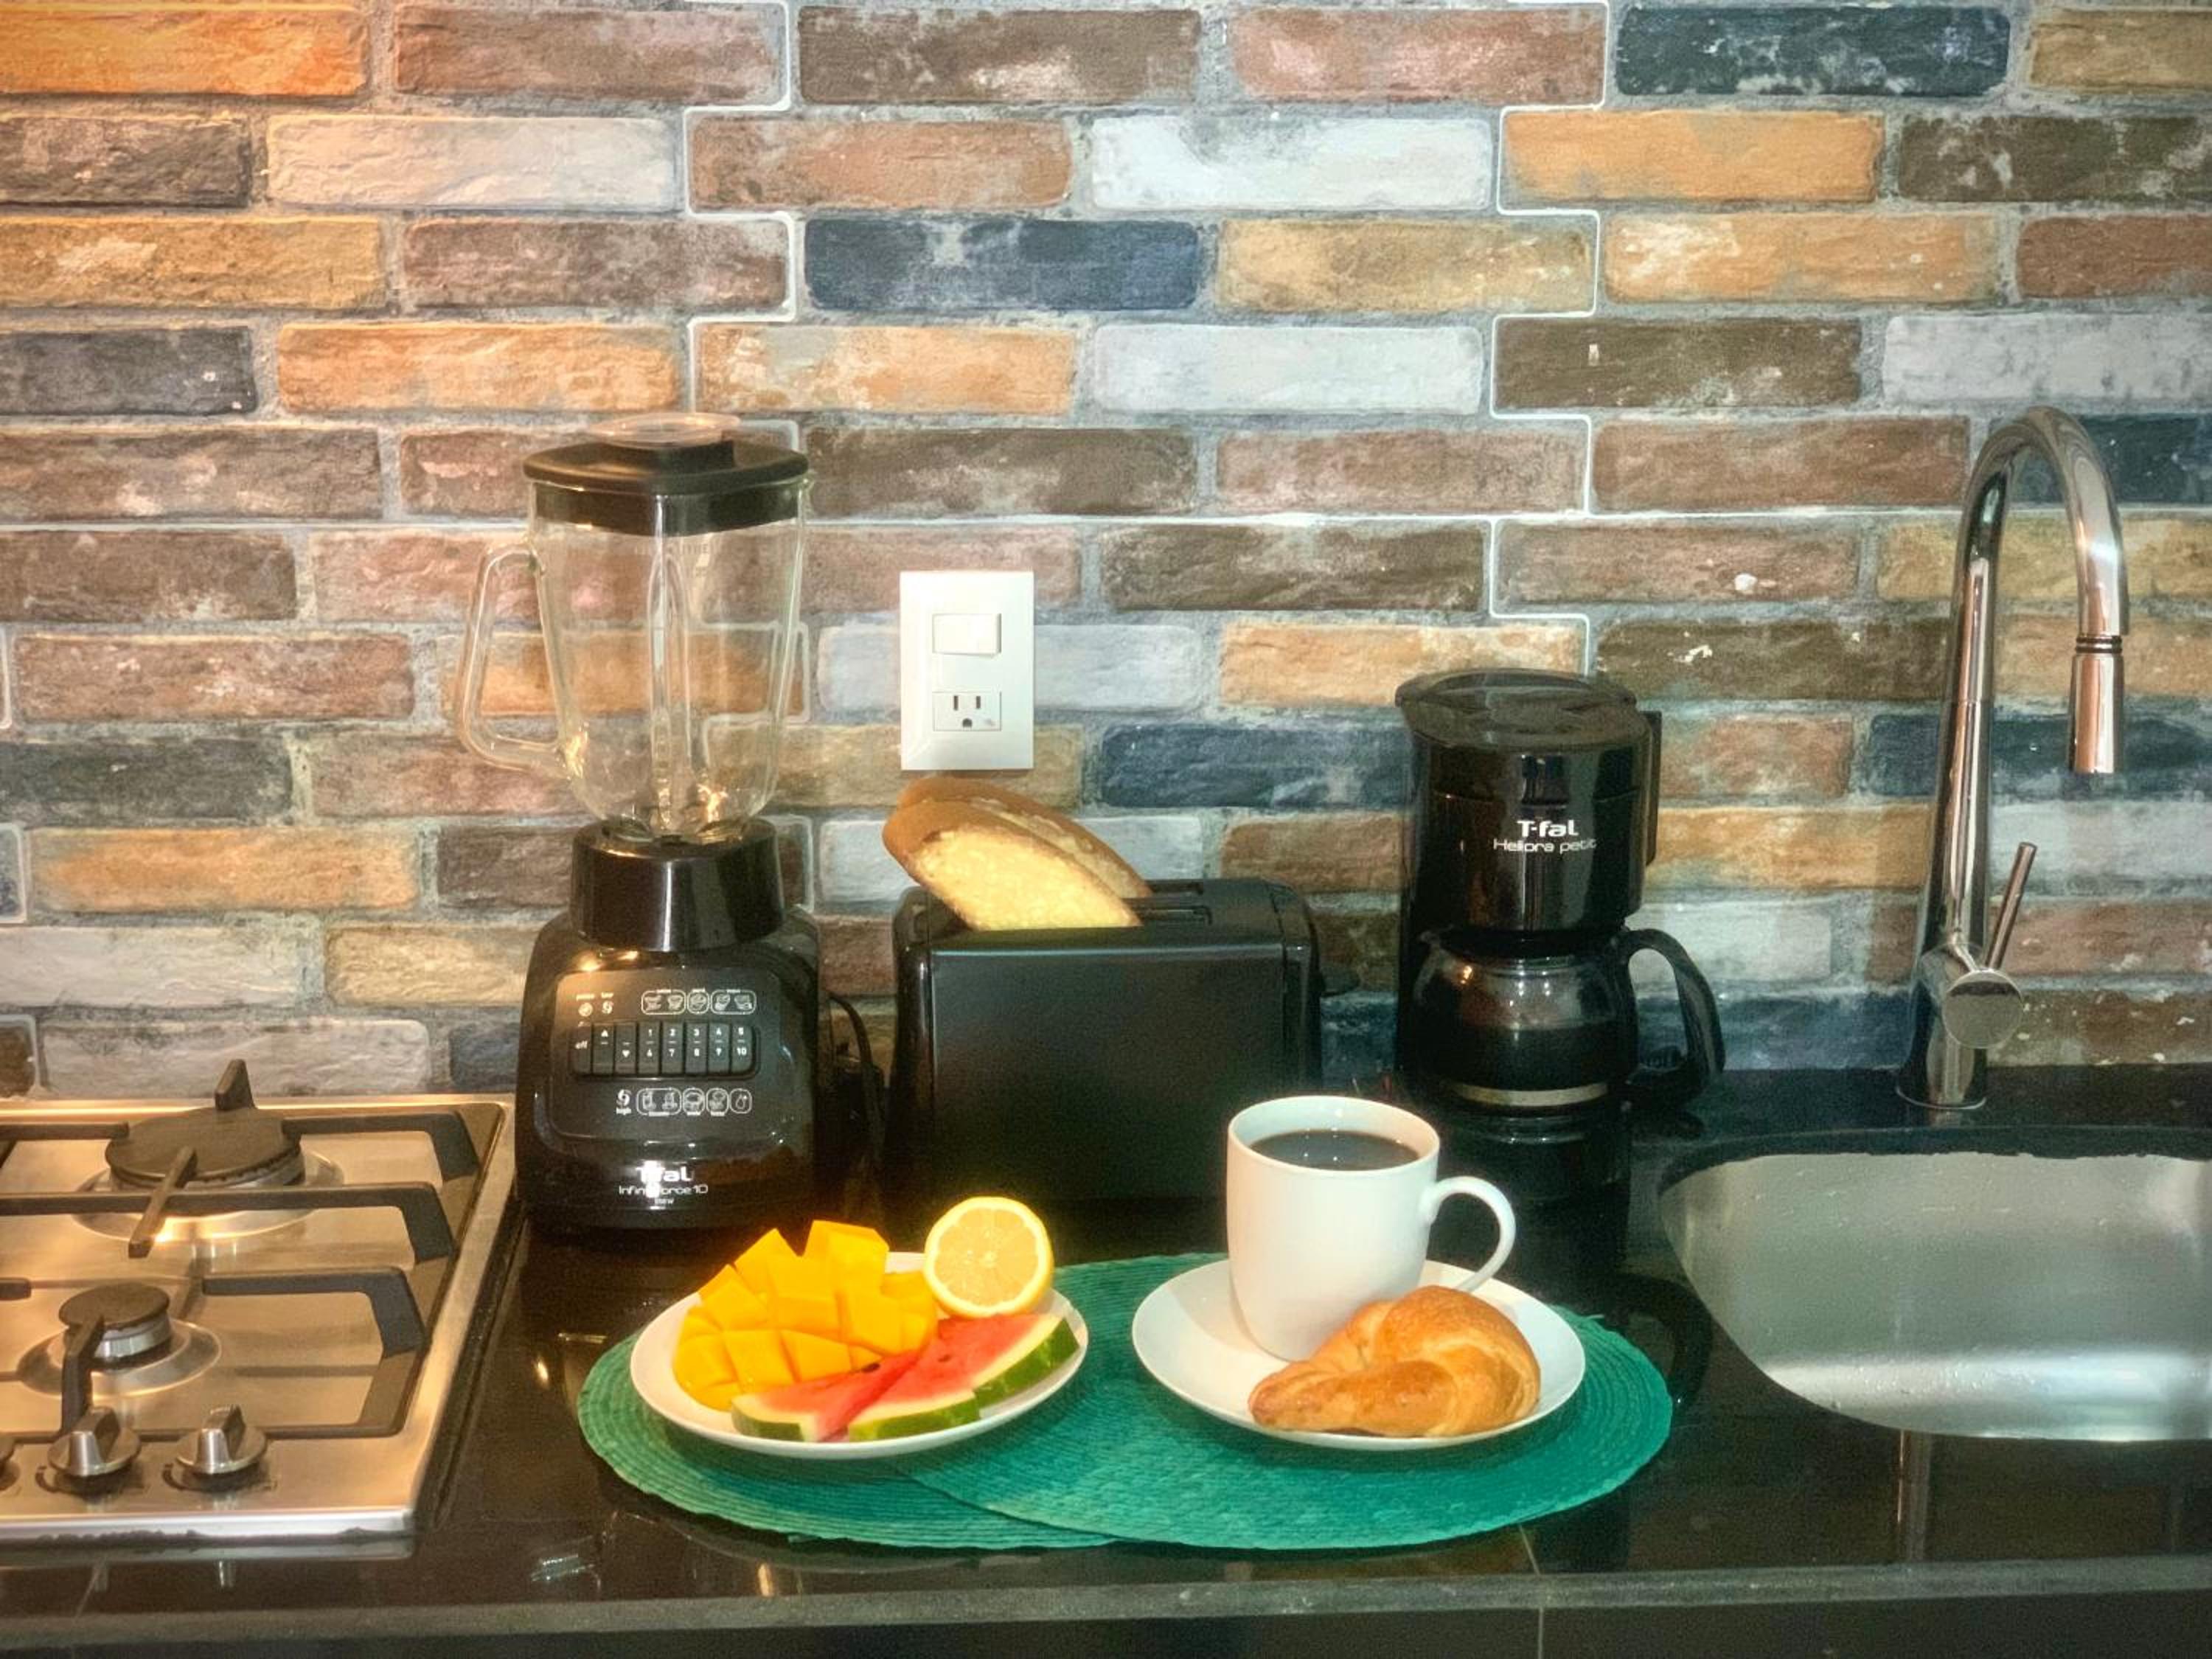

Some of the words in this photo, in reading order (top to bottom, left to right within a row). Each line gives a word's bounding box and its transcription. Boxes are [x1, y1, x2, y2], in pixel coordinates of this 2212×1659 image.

[1517, 818, 1579, 838] T-fal
[669, 1028, 677, 1037] 2
[693, 1028, 700, 1037] 3
[668, 1048, 676, 1057] 7
[737, 1047, 748, 1057] 10
